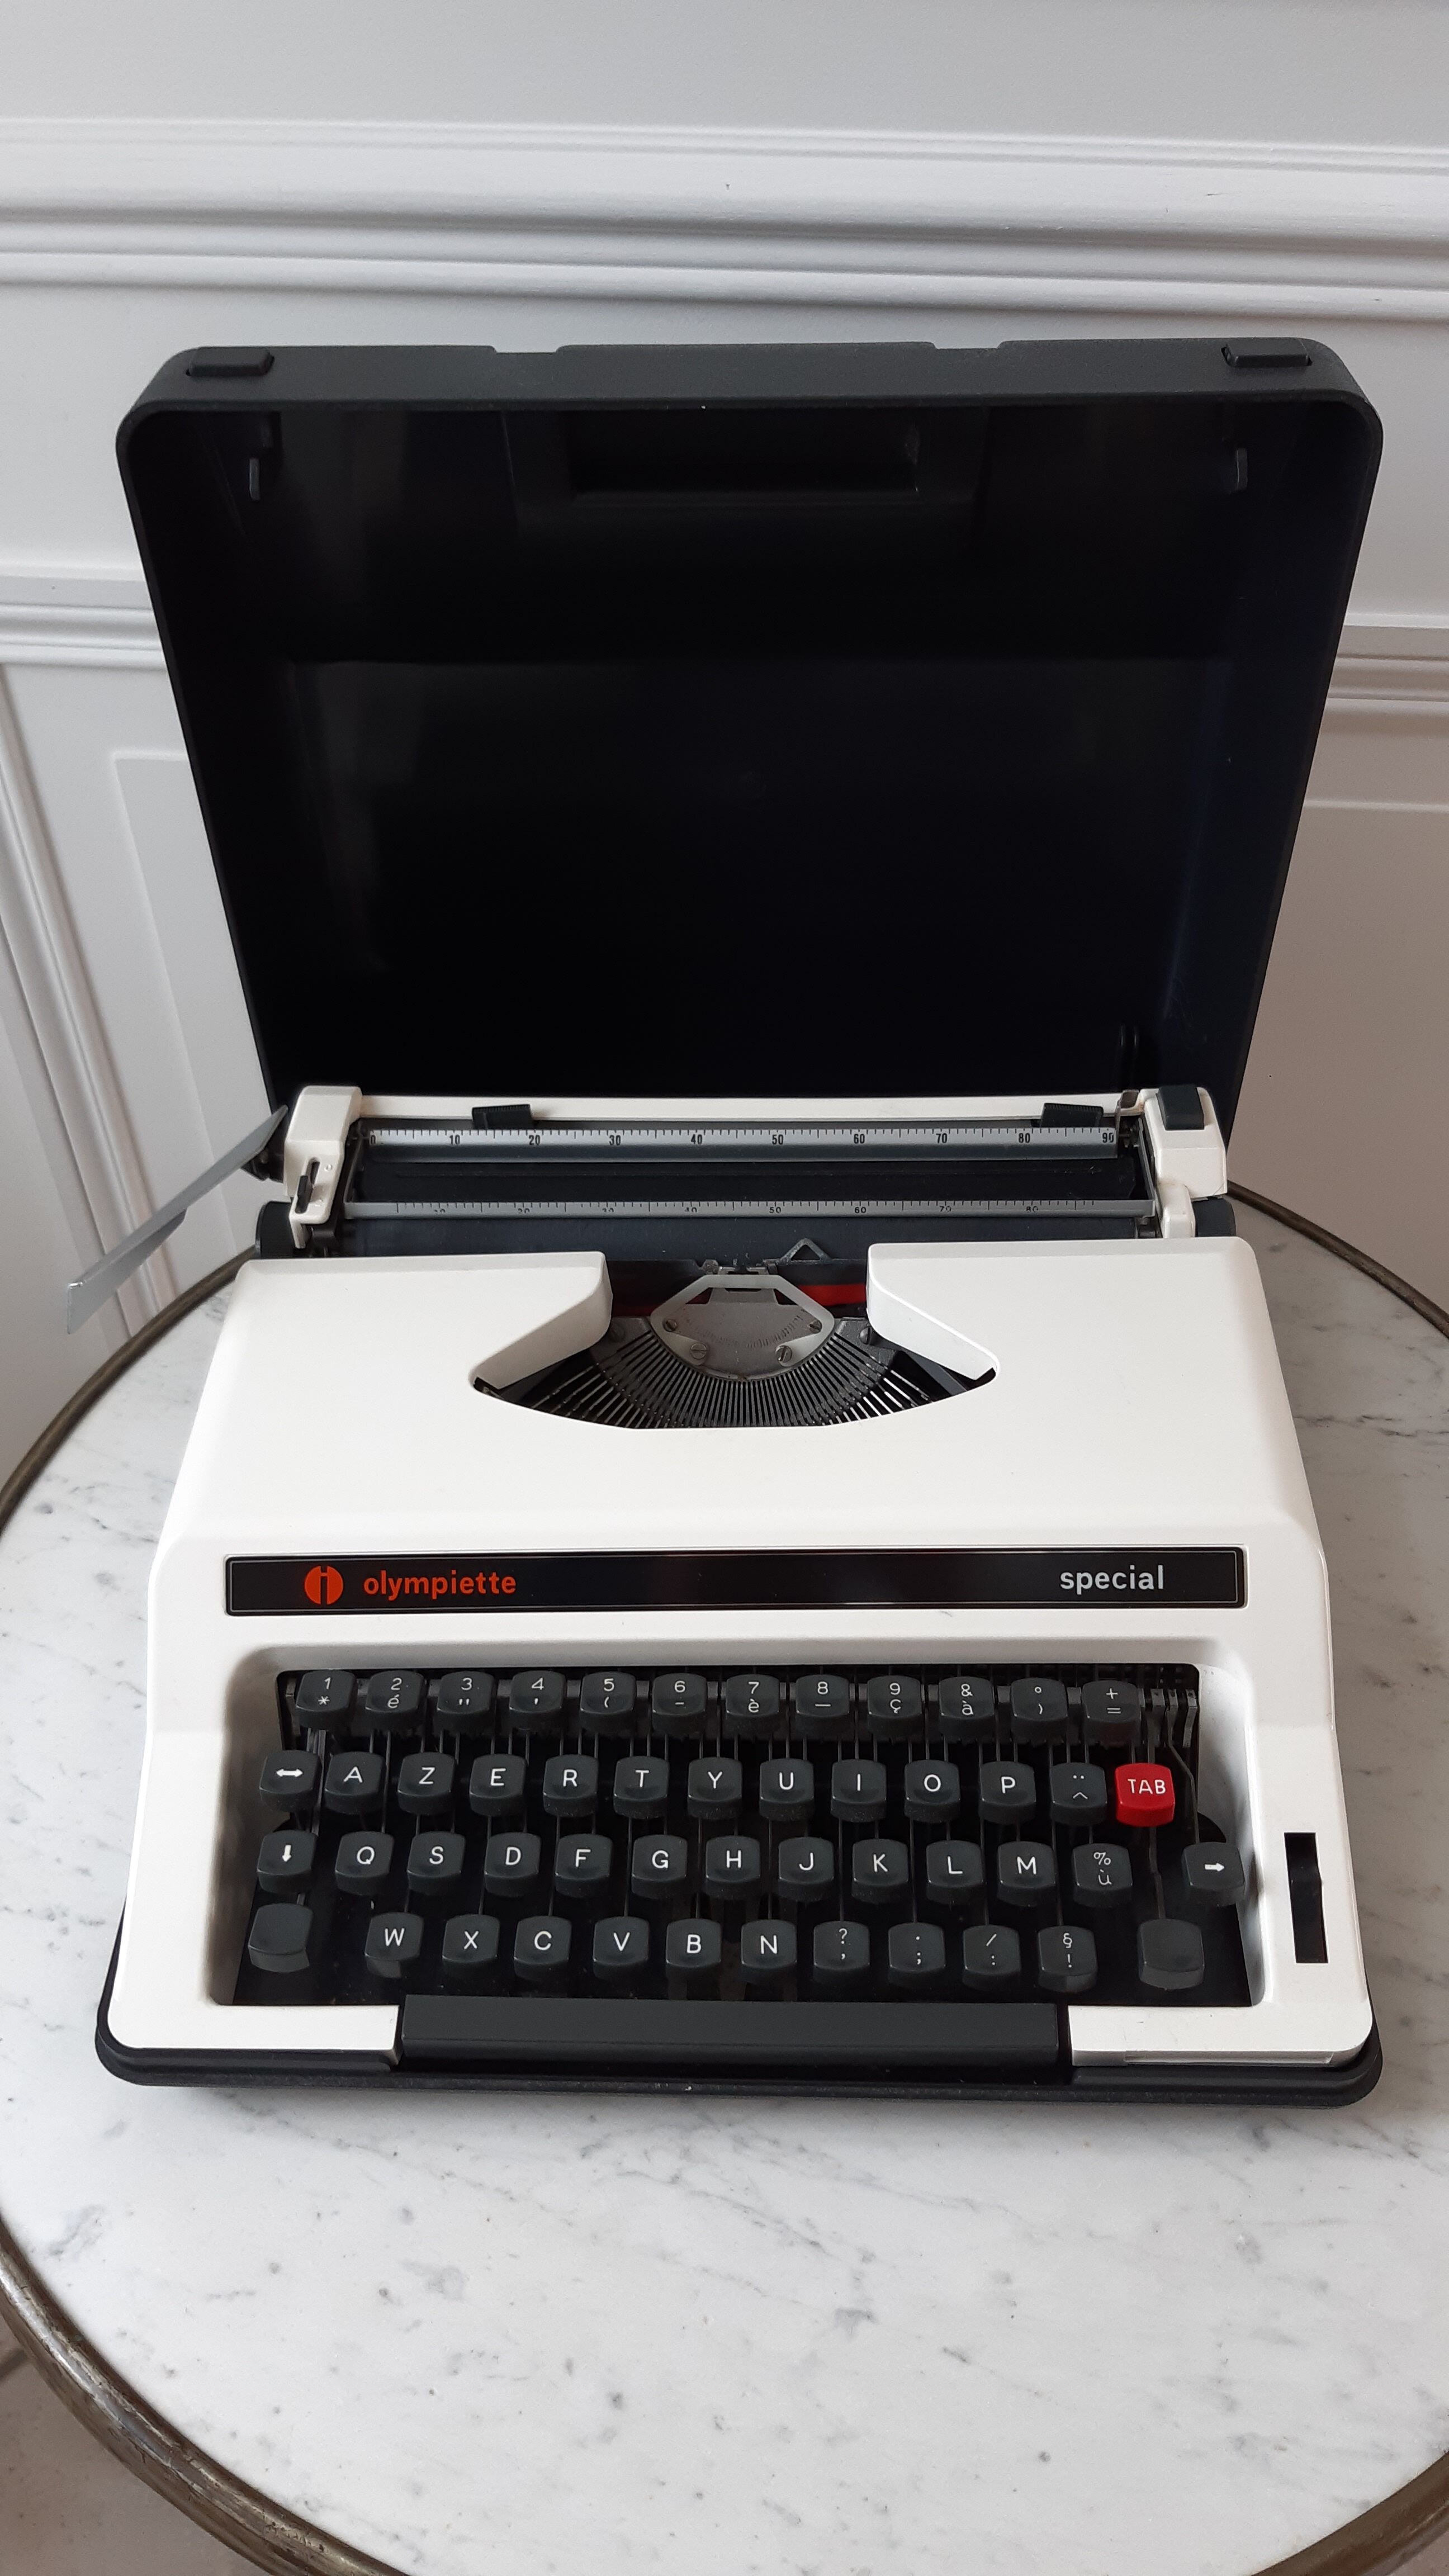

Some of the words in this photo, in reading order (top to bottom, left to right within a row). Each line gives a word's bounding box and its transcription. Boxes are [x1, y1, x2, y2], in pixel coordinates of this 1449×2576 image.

[449, 1134, 460, 1145] 10
[529, 1134, 541, 1146] 20
[609, 1134, 621, 1146] 30
[690, 1134, 703, 1146] 40
[771, 1134, 783, 1146] 50
[854, 1133, 865, 1145] 60
[936, 1133, 948, 1144] 70
[1019, 1133, 1030, 1144] 80
[1102, 1132, 1114, 1143] 90
[363, 1569, 515, 1600] olympiette
[1060, 1565, 1163, 1595] special
[325, 1677, 330, 1689] 1
[391, 1678, 402, 1690] 2
[461, 1678, 472, 1690] 3
[531, 1678, 544, 1690] 4
[604, 1678, 614, 1692] 5
[674, 1680, 685, 1693] 6
[749, 1682, 759, 1694] 7
[817, 1681, 828, 1694] 8
[889, 1683, 901, 1695] 9
[961, 1683, 973, 1697] &
[387, 1694, 400, 1708] é
[1106, 1688, 1118, 1699] +
[604, 1697, 609, 1708] (
[748, 1698, 759, 1713] è
[962, 1700, 974, 1715] à
[1038, 1703, 1043, 1715] )
[343, 1767, 363, 1783] A
[419, 1767, 435, 1784] Z
[490, 1768, 506, 1786] E
[563, 1769, 577, 1787] R
[636, 1770, 650, 1788] T
[708, 1772, 722, 1789] Y
[779, 1772, 794, 1790] U
[857, 1774, 861, 1791] I
[924, 1774, 941, 1792] O
[1001, 1776, 1016, 1793] P
[1128, 1778, 1166, 1794] TAB
[357, 1846, 375, 1864] Q
[429, 1846, 443, 1864] S
[505, 1846, 521, 1865] D
[575, 1849, 591, 1867] F
[652, 1850, 669, 1868] G
[726, 1850, 741, 1868] H
[799, 1853, 814, 1871] J
[873, 1854, 888, 1872] K
[1093, 1852, 1111, 1865] %
[948, 1856, 963, 1874] L
[1017, 1857, 1036, 1874] M
[1098, 1869, 1112, 1885] ù
[385, 1928, 405, 1947] W
[464, 1931, 479, 1949] X
[534, 1931, 552, 1950] C
[613, 1932, 630, 1951] V
[686, 1934, 702, 1953] B
[839, 1928, 847, 1944] ?
[986, 1934, 997, 1947] /
[1063, 1933, 1073, 1949] §
[760, 1935, 778, 1954] N
[917, 1952, 921, 1965] ;
[991, 1955, 995, 1966] :
[1067, 1954, 1072, 1968] !
